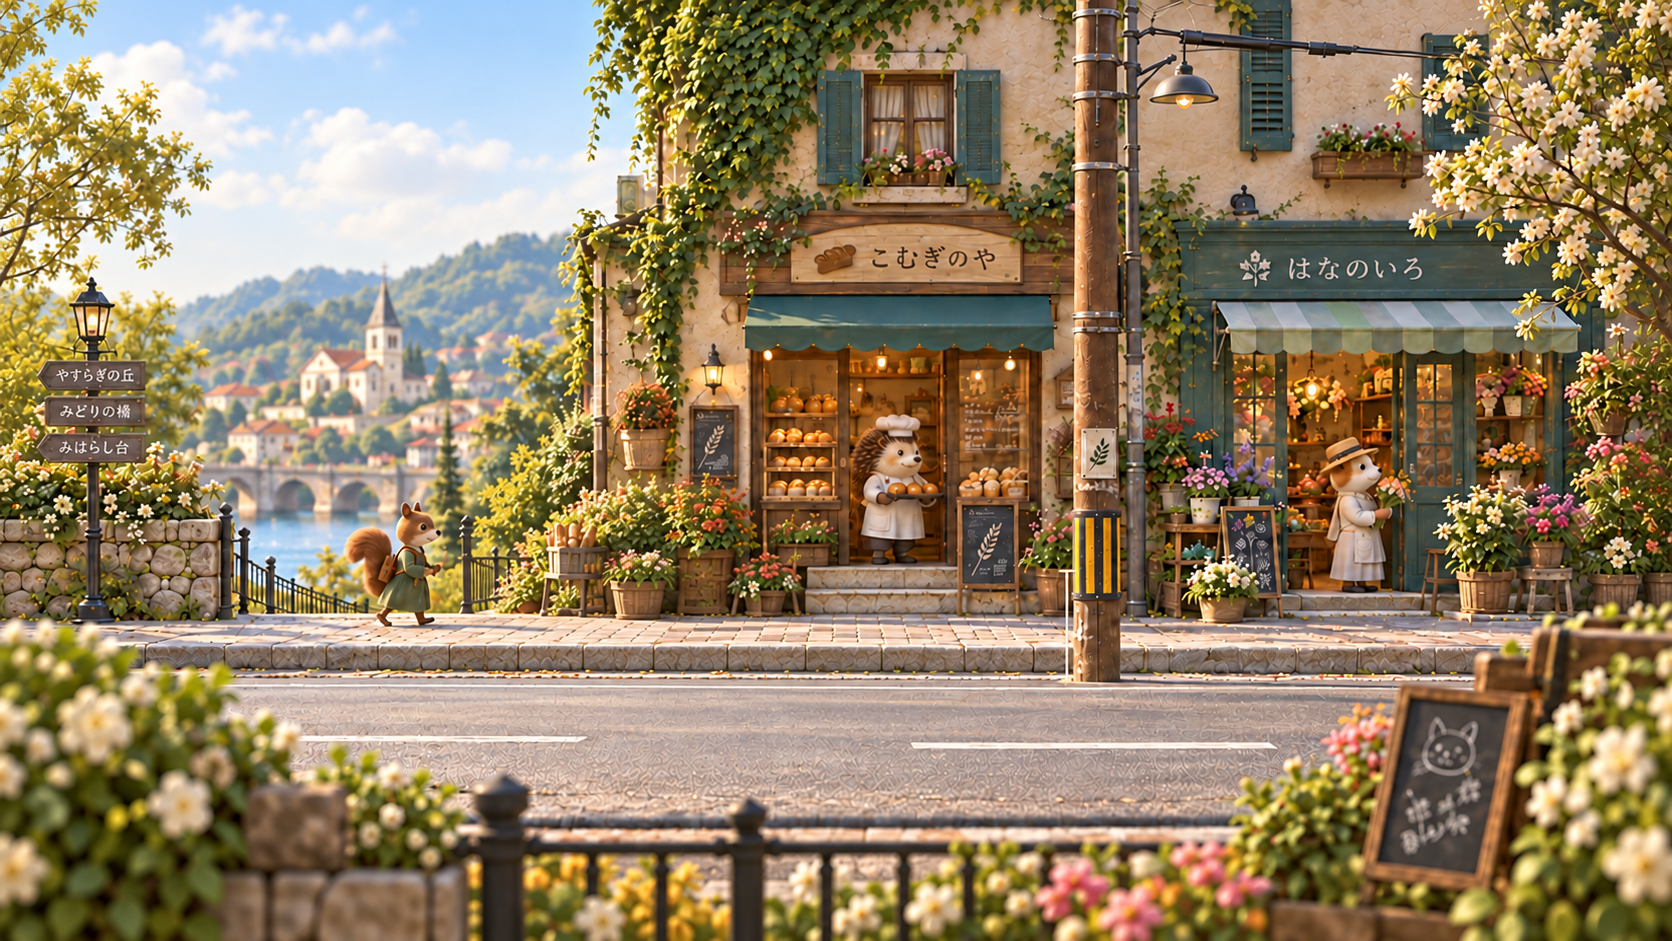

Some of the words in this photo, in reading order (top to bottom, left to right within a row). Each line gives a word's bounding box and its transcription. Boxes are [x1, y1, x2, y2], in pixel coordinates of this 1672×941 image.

[872, 245, 996, 270] こむぎのや
[1288, 256, 1423, 280] はなのいろ
[56, 368, 134, 382] やすらぎの丘
[59, 440, 129, 454] みはらし台
